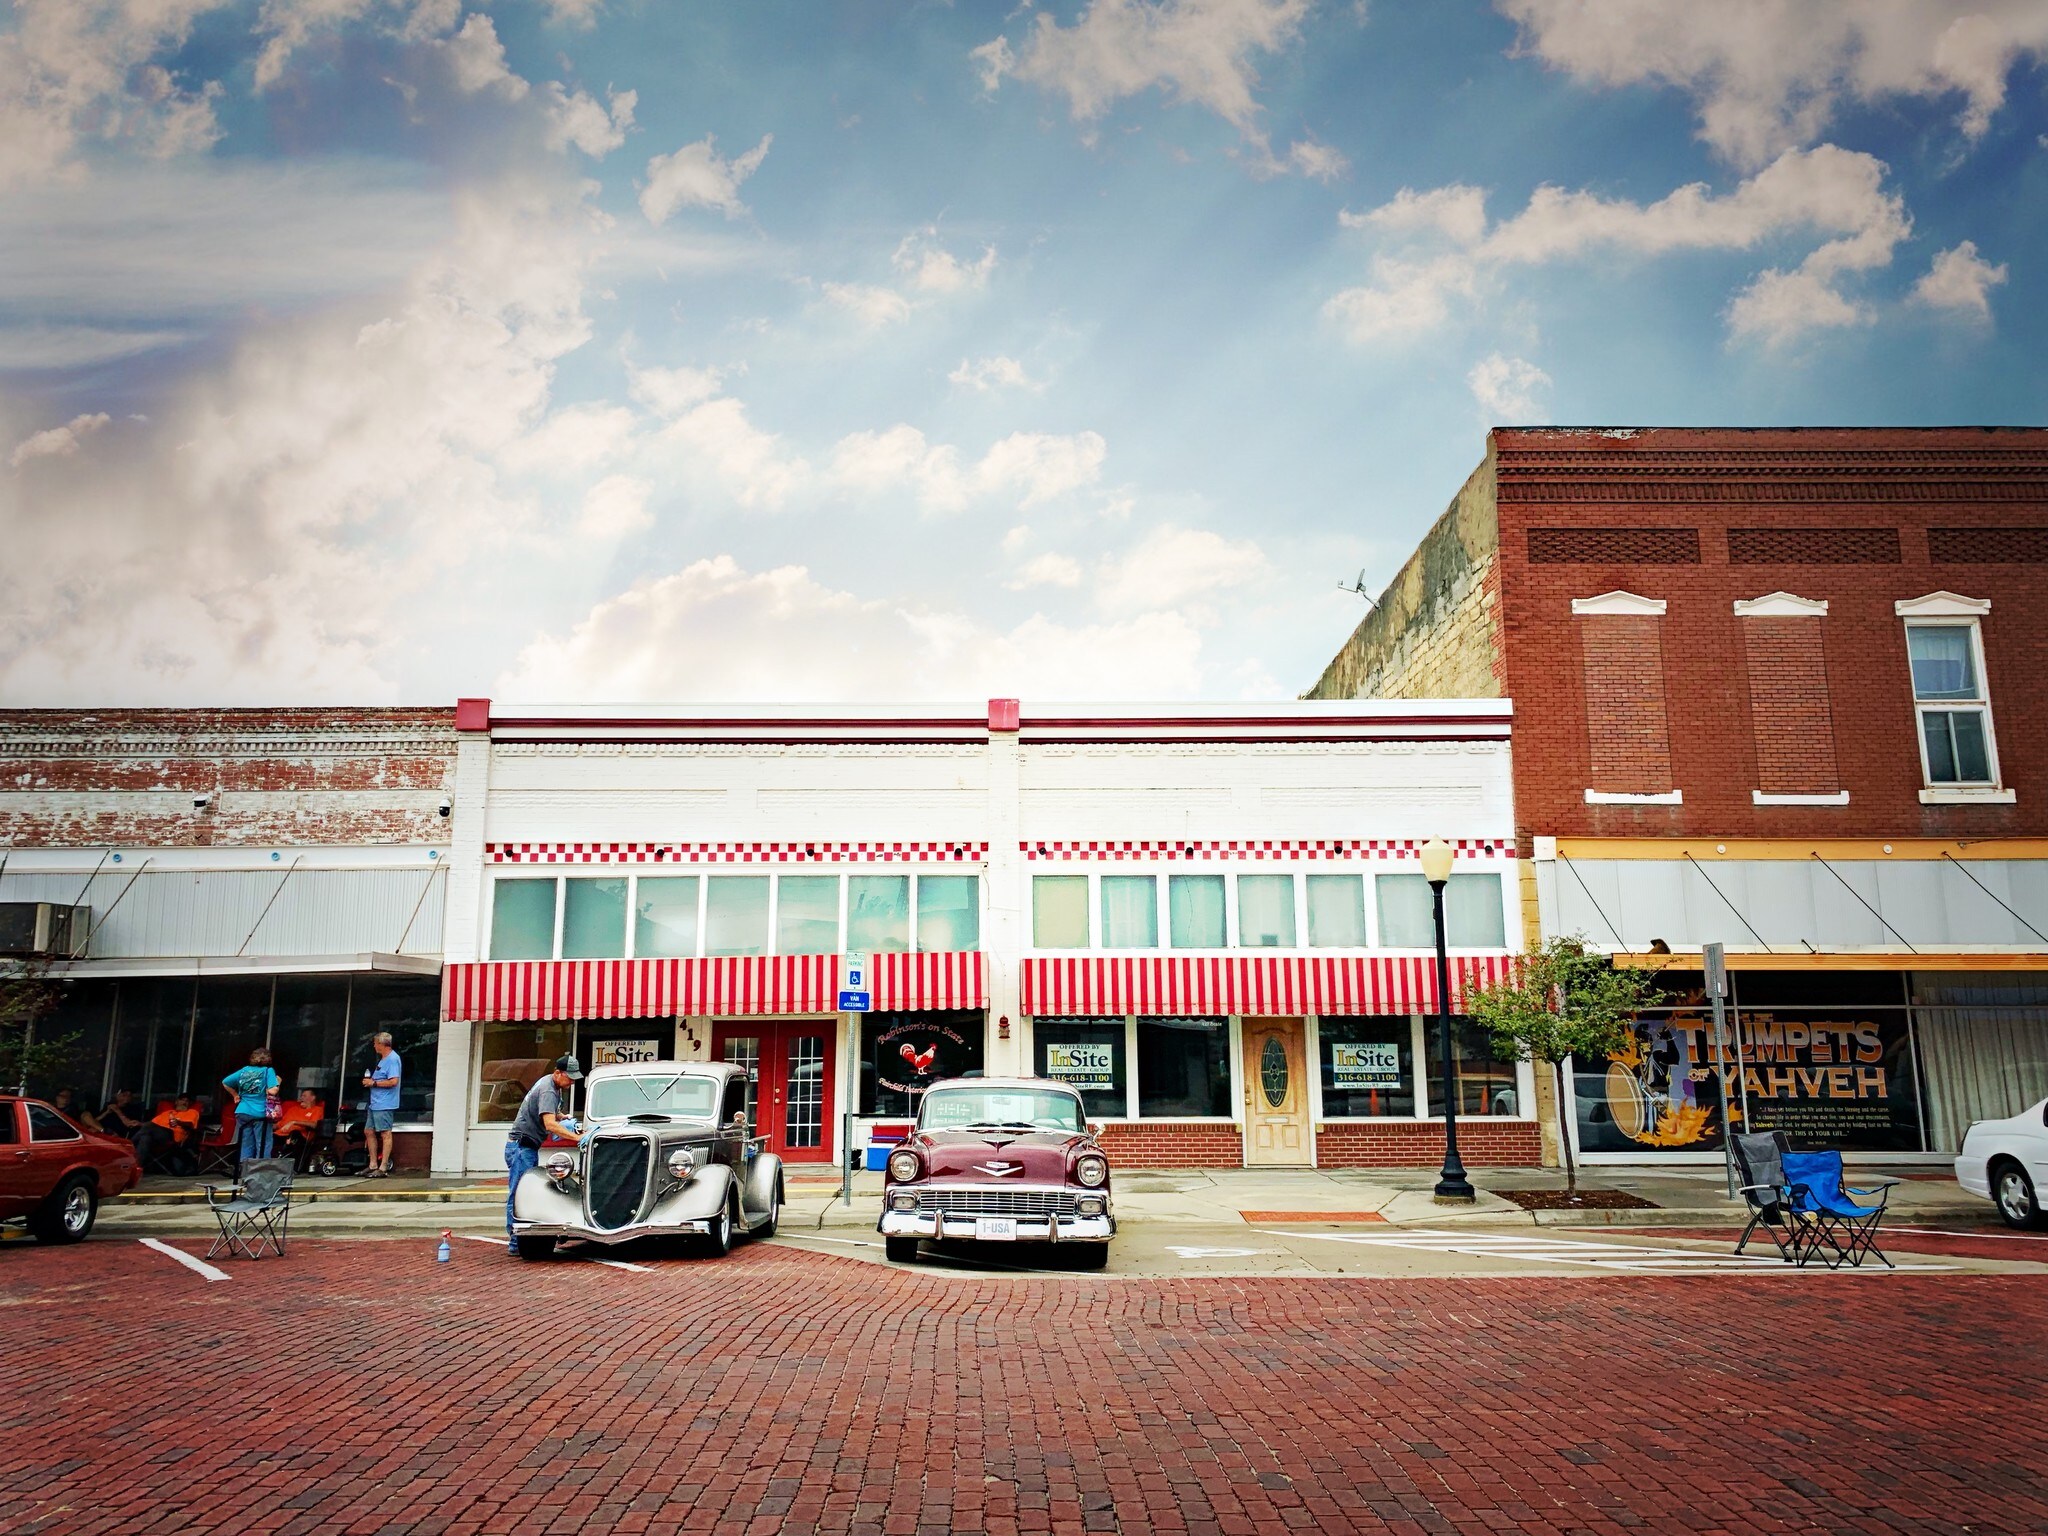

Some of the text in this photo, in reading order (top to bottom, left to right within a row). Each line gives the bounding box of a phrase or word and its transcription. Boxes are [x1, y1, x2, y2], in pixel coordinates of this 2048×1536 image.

[679, 1019, 702, 1052] 419
[878, 1022, 965, 1045] Robinson's on State
[1676, 1018, 1883, 1063] TRUMPETS
[595, 1046, 655, 1064] InSite
[1050, 1049, 1109, 1068] InSite
[1336, 1049, 1395, 1067] InSite
[1051, 1073, 1110, 1082] 316-618-1100
[1337, 1073, 1397, 1082] 316-618-1100
[1709, 1065, 1889, 1099] YAHVEH
[982, 1222, 1010, 1234] 1-USA
